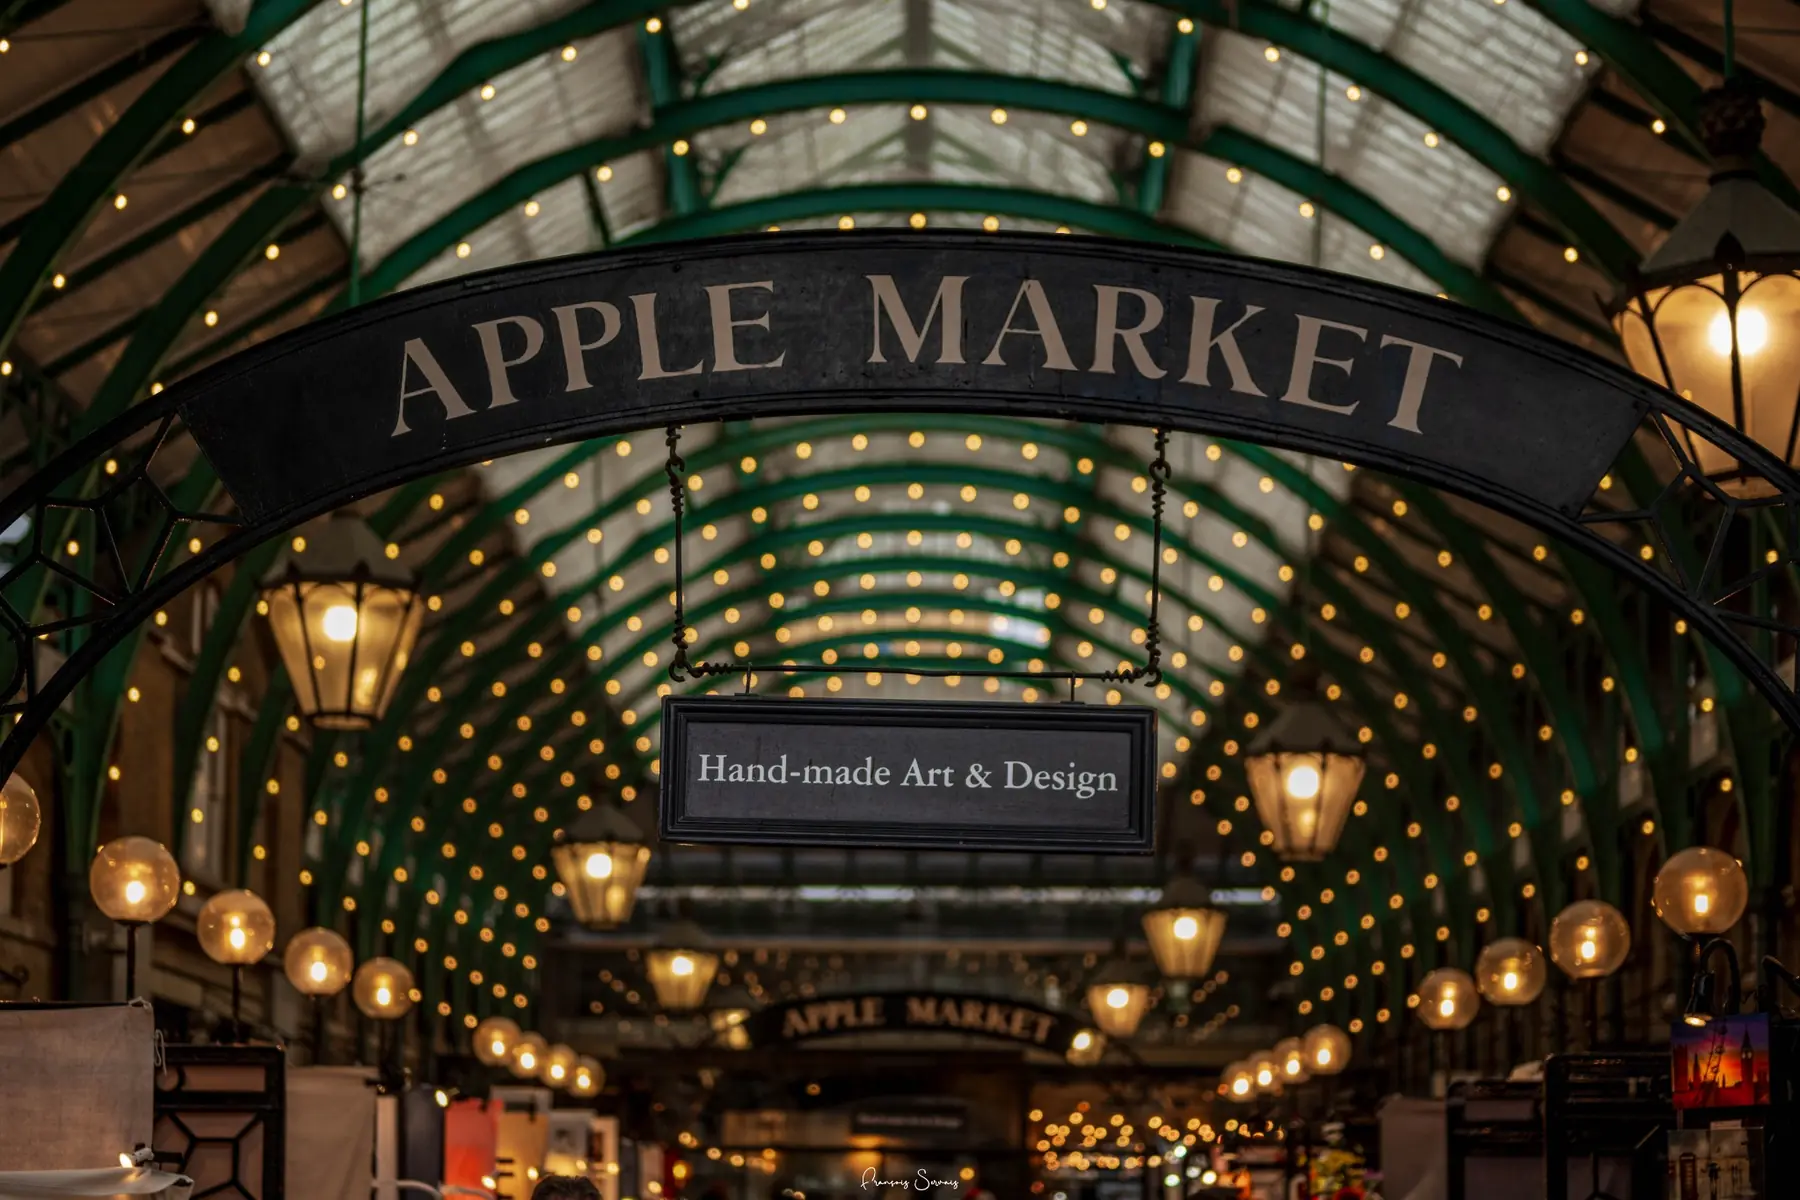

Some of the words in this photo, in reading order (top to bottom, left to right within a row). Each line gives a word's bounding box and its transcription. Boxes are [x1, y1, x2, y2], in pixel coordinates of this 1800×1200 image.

[391, 280, 786, 438] APPLE
[865, 274, 1464, 435] MARKET
[698, 753, 891, 787] Hand-made
[900, 757, 955, 788] Art
[965, 762, 993, 789] &
[1003, 760, 1119, 799] Design
[782, 997, 886, 1038] APPLE
[905, 997, 1057, 1043] MARKET
